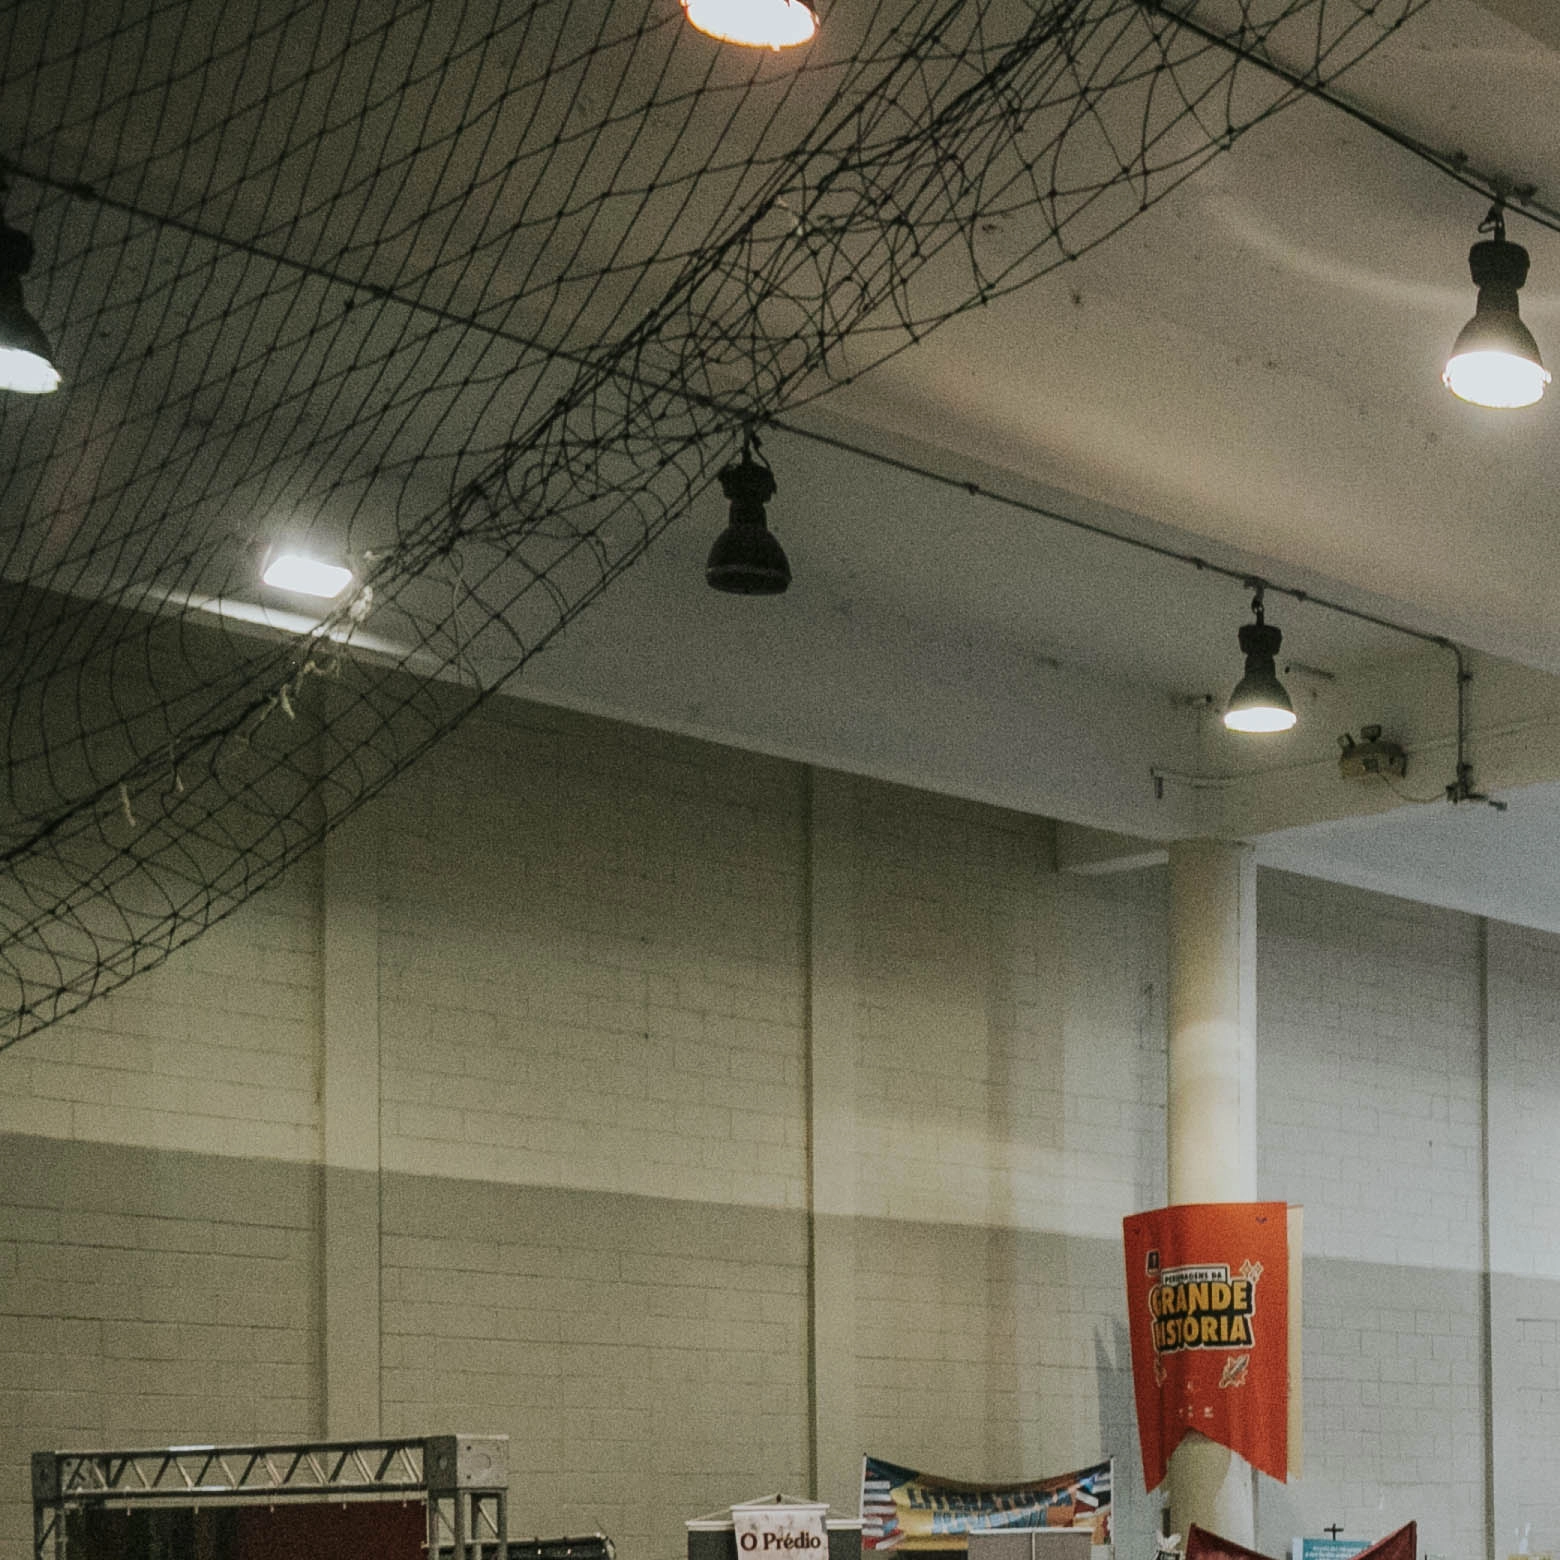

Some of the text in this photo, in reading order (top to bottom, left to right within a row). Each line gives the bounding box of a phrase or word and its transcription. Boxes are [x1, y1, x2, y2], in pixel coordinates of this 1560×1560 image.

[1151, 1280, 1248, 1316] GRANDE
[1154, 1309, 1248, 1349] HISTÓRIA
[740, 1531, 821, 1551] O Prédio
